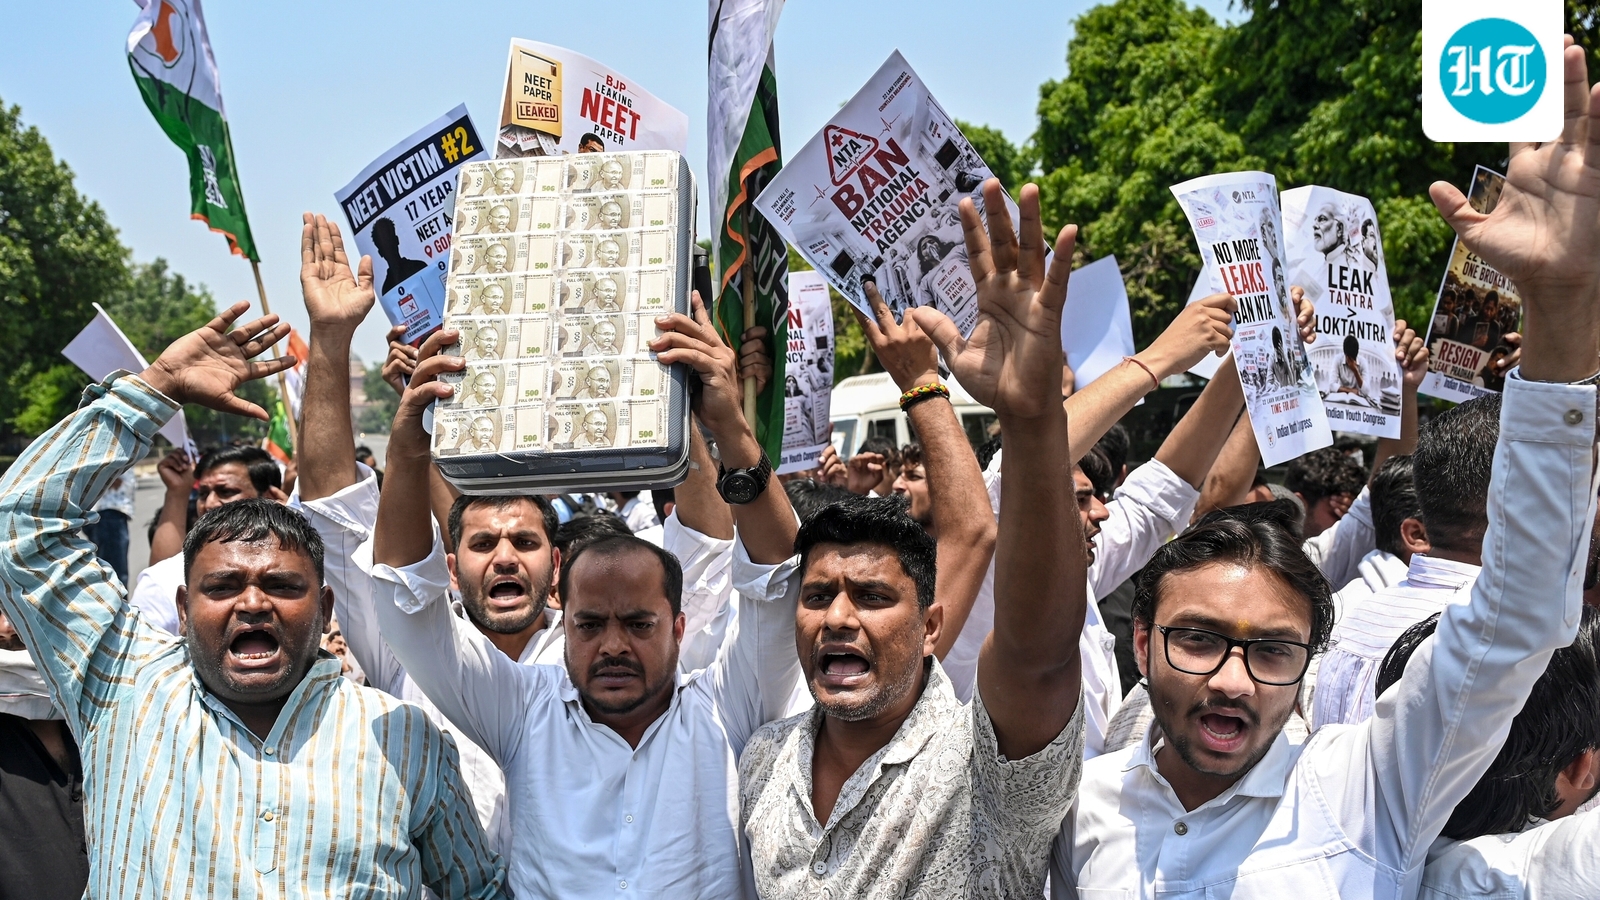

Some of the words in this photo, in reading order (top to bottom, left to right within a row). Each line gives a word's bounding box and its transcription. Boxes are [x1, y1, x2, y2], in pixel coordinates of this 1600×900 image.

[524, 73, 552, 90] NEET
[606, 74, 626, 92] BJP
[886, 85, 895, 95] LAKH
[524, 85, 552, 101] PAPER
[596, 82, 633, 108] LEAKING
[520, 105, 556, 119] LEAKED
[580, 87, 641, 141] NEET
[593, 124, 624, 146] PAPER
[833, 138, 863, 168] NTA
[347, 180, 384, 229] NEET
[379, 143, 444, 200] VICTIM
[440, 126, 474, 164] #2
[830, 138, 909, 220] BAN
[404, 200, 419, 221] 17
[419, 182, 453, 212] YEAR
[778, 192, 786, 201] CALL
[850, 165, 920, 232] NATIONAL
[1242, 191, 1255, 199] NTA
[783, 204, 792, 213] CALL
[860, 178, 929, 243] TRAUMA
[416, 220, 442, 242] NEET
[875, 198, 937, 255] AGENCY.
[1213, 242, 1232, 264] NO
[1232, 239, 1261, 262] MORE
[945, 276, 963, 296] SYSTEM
[1220, 262, 1268, 295] LEAKS.
[1328, 263, 1373, 296] LEAK
[1463, 262, 1479, 278] ONE
[1479, 268, 1506, 289] BROKEN
[949, 281, 968, 301] FAILURE
[1329, 290, 1373, 310] TANTRA
[1254, 294, 1276, 321] NTA.
[1315, 315, 1386, 344] LOKTANTRA
[1438, 341, 1481, 370] RESIGN
[1450, 366, 1475, 380] PRADHAN
[1444, 378, 1458, 390] Indian
[1458, 382, 1471, 394] Youth
[1326, 406, 1344, 419] Indian
[1345, 408, 1361, 422] Youth
[1363, 410, 1386, 426] Congress
[789, 453, 802, 463] Youth
